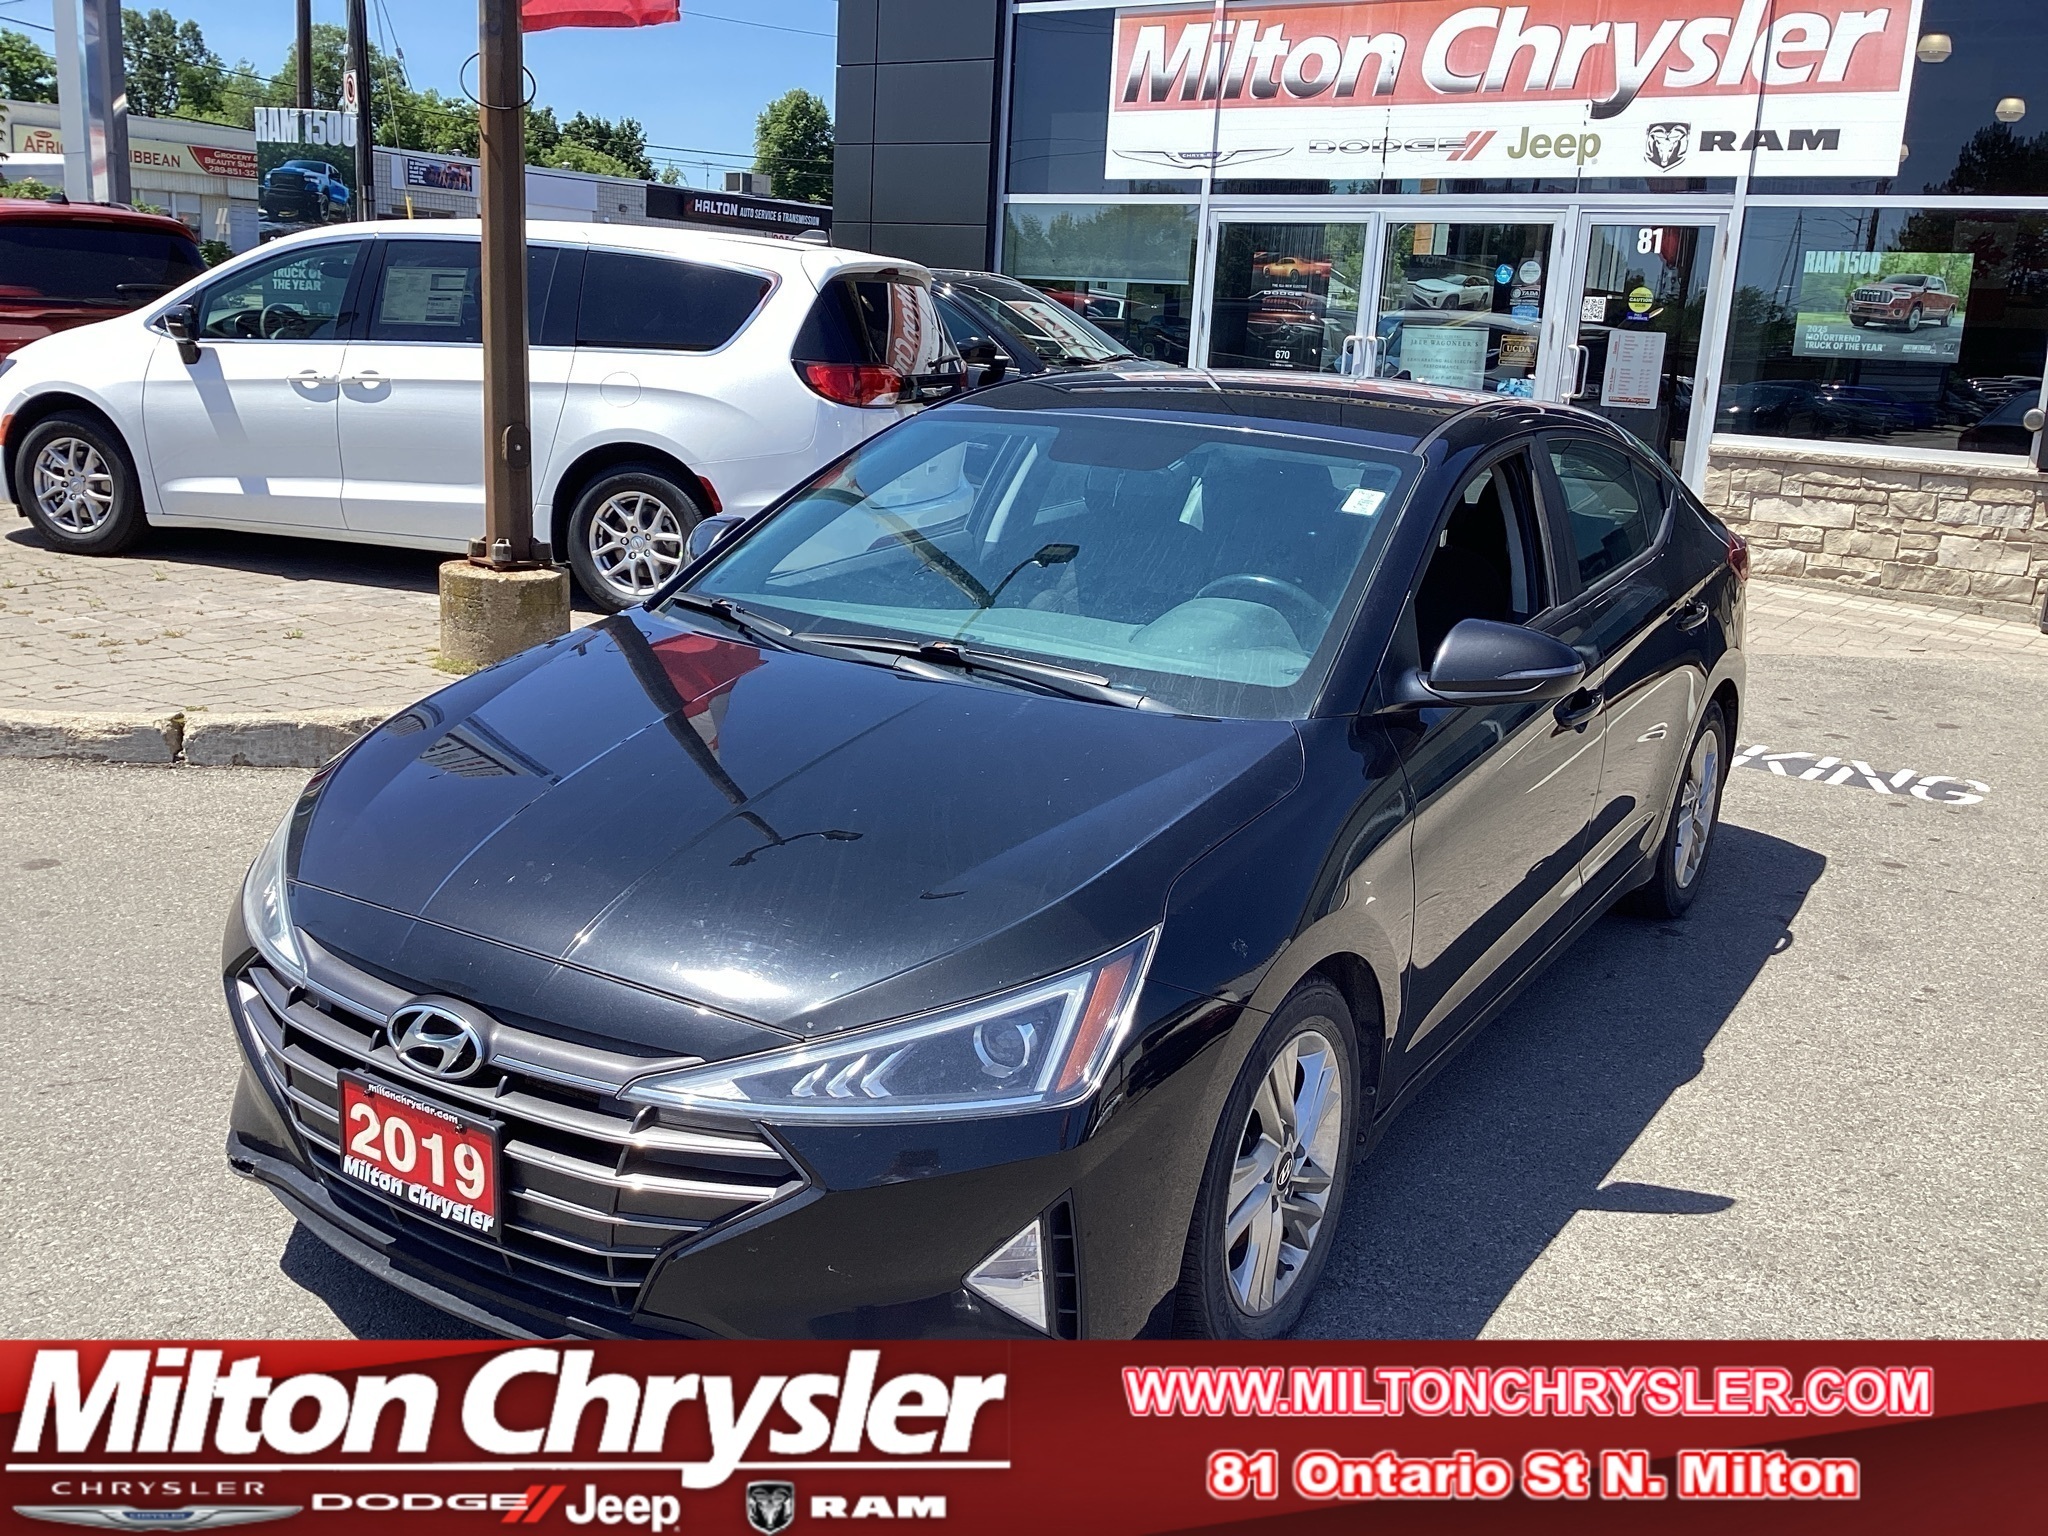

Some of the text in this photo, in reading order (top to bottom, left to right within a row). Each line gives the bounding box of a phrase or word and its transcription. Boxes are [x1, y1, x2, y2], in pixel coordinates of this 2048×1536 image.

[1122, 0, 1890, 119] Milton Chrysler
[253, 107, 299, 143] RAM
[1309, 137, 1468, 154] DODGE
[1507, 126, 1602, 166] Jeep
[1699, 129, 1841, 152] RAM
[694, 198, 739, 217] HALTON
[739, 206, 754, 218] AUTO
[754, 208, 777, 221] SERVICE
[782, 212, 820, 226] TRANSMISSION
[1637, 228, 1664, 254] 81
[1803, 251, 1881, 274] RAM 1500
[272, 278, 321, 291] THE YEAR
[1805, 333, 1861, 342] MOTORTREND
[1806, 325, 1828, 333] 2025
[1275, 349, 1290, 359] 670
[1506, 344, 1531, 353] UCDA
[1805, 341, 1831, 350] TRUCK
[1832, 342, 1844, 350] OF
[1844, 343, 1860, 351] THE
[367, 1083, 459, 1125] miltonchrysler.com
[350, 1102, 486, 1201] 2019
[342, 1155, 495, 1233] Milton Chrysler
